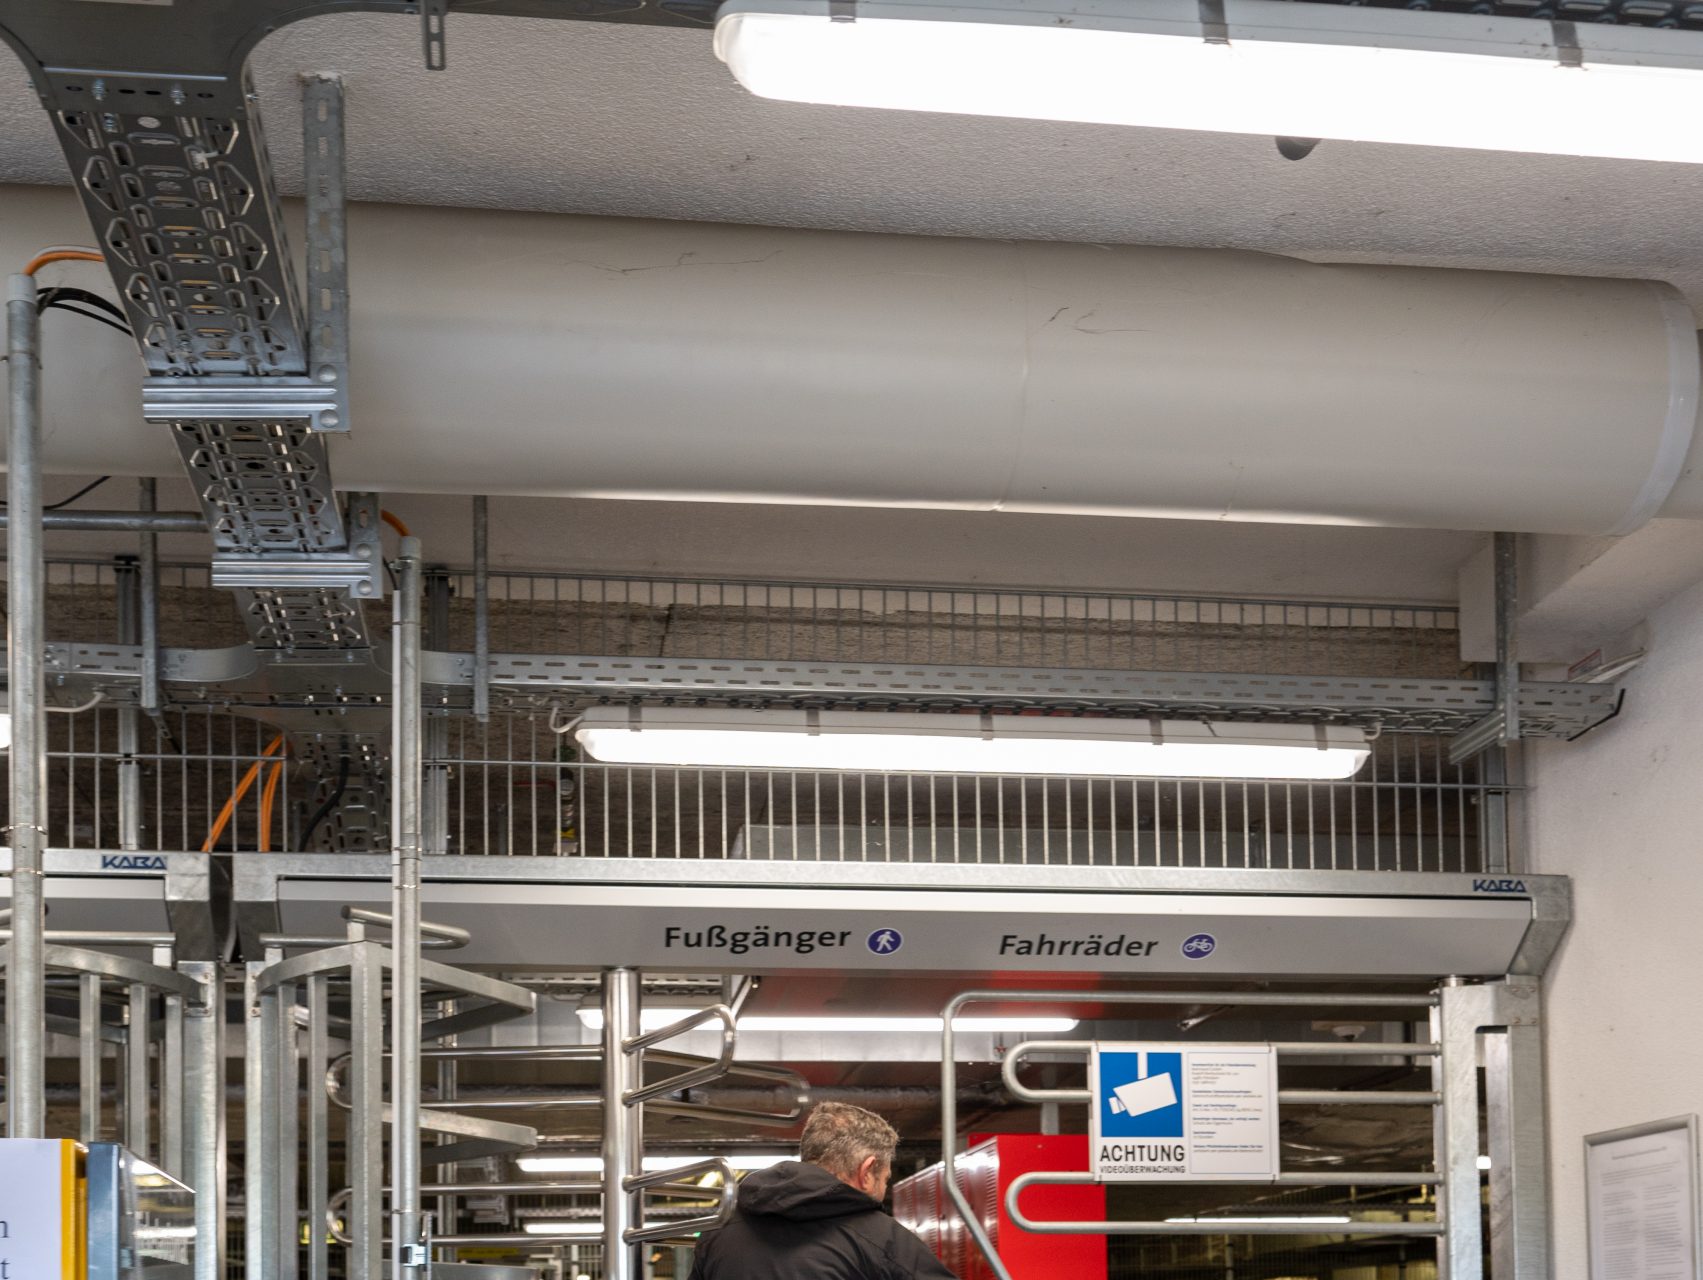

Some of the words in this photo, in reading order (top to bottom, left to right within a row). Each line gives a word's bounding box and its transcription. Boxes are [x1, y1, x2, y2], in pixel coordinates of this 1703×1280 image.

[101, 855, 168, 870] KABA
[1472, 879, 1527, 893] KABA
[665, 925, 852, 955] Fußgänger
[999, 934, 1159, 957] Fahrräder
[1100, 1144, 1185, 1162] ACHTUNG
[1100, 1164, 1186, 1174] VIDEOÜBERWACHUNG
